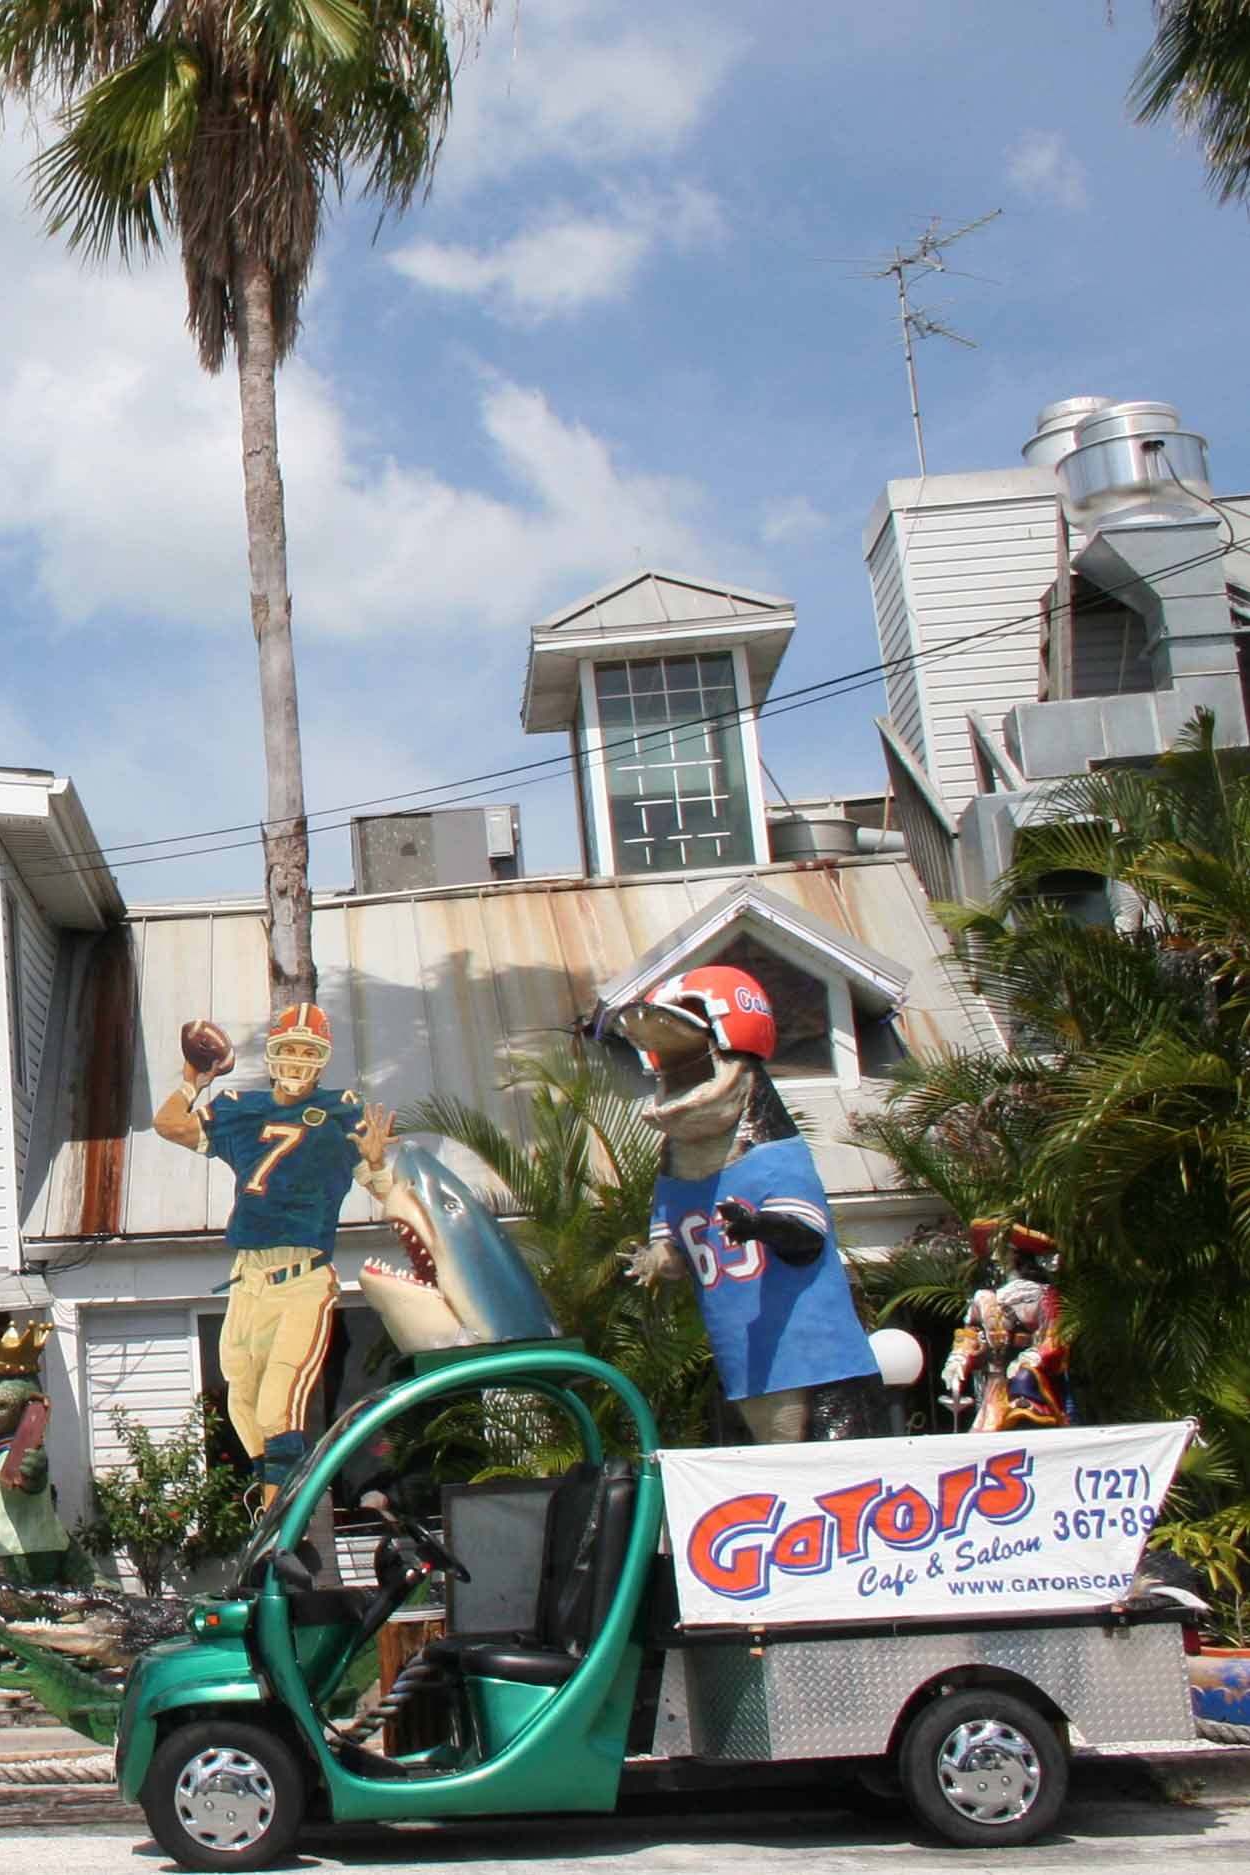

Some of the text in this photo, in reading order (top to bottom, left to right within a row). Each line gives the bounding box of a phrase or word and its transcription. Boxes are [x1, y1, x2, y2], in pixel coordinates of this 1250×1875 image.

[245, 1122, 308, 1195] 7
[1074, 1464, 1152, 1504] (727)
[857, 1534, 1044, 1597] Cafe & Saloon
